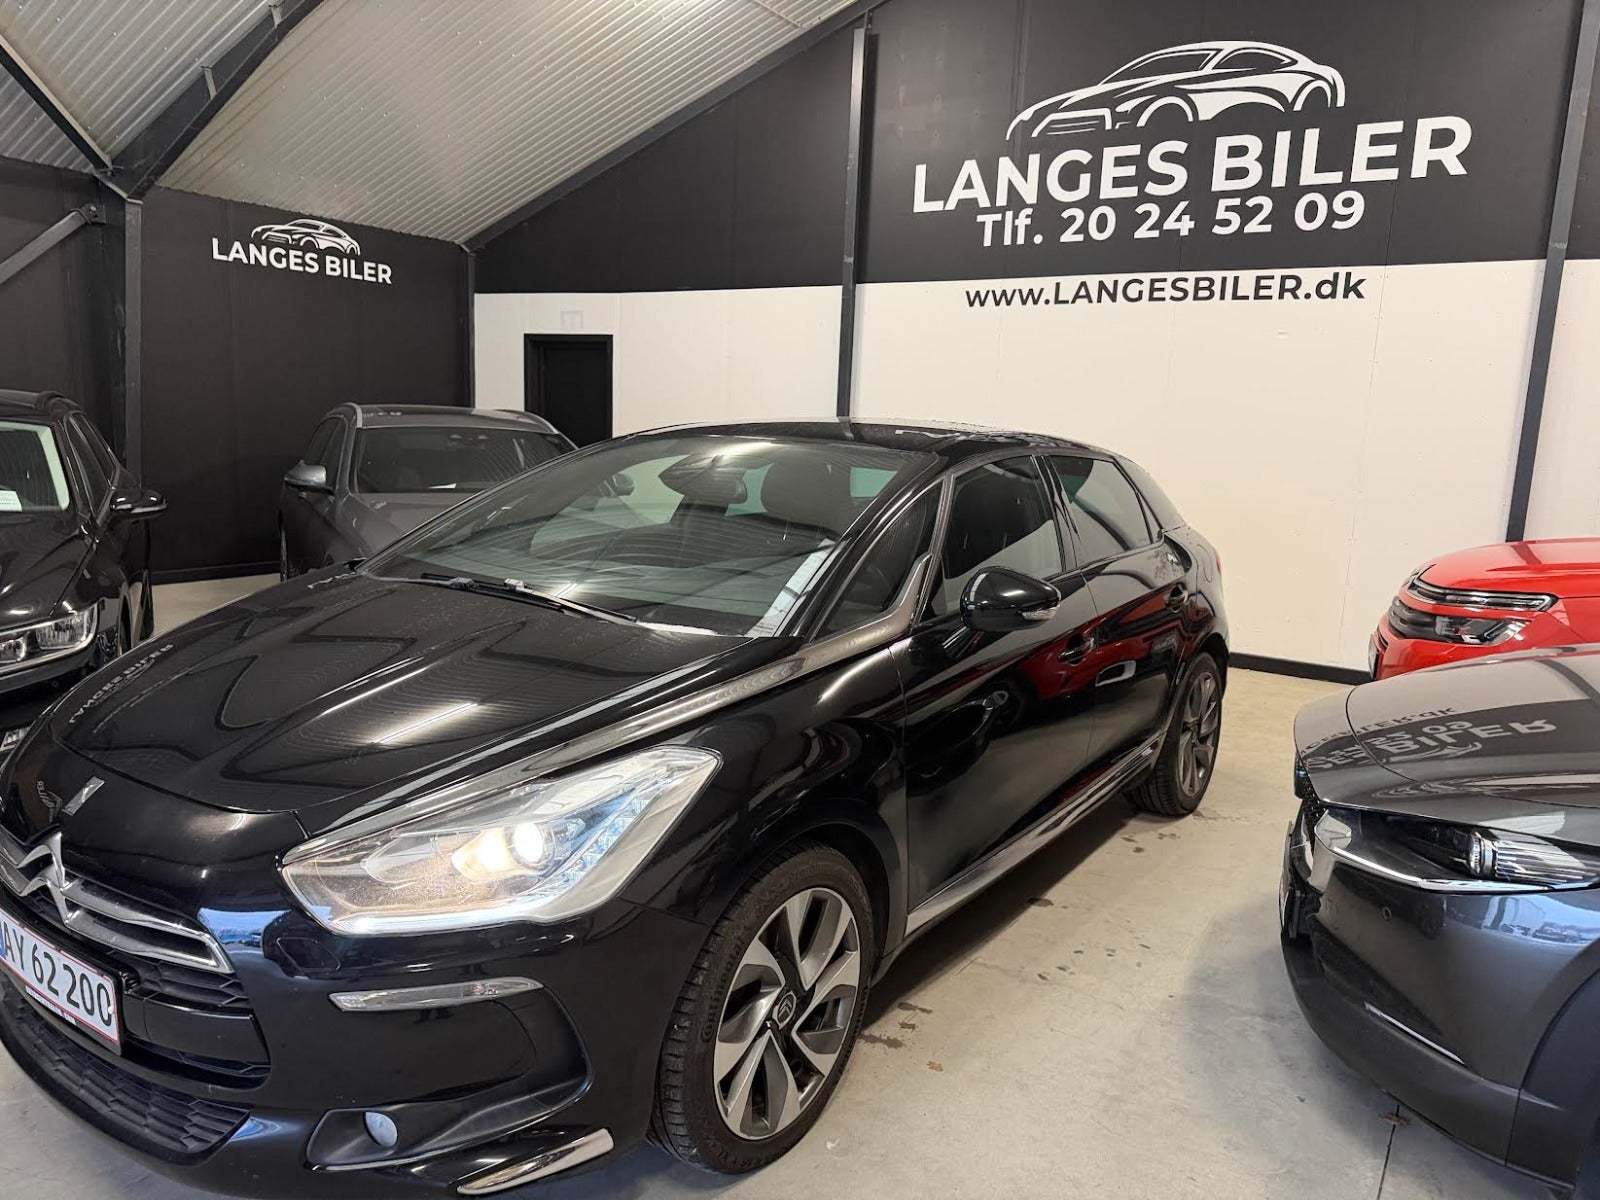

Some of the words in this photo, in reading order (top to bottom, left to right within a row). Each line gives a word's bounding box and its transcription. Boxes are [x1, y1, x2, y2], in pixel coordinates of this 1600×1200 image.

[912, 141, 1189, 213] LANGES
[1211, 116, 1472, 191] BILER
[976, 208, 1043, 247] Tlf.
[1060, 206, 1117, 243] 20
[1134, 201, 1195, 239] 24
[1212, 196, 1273, 234] 52
[1294, 191, 1365, 230] 09
[212, 238, 320, 274] LANGES
[325, 256, 392, 285] BILER
[965, 271, 1367, 308] www.LANGESBILER.dk
[3, 921, 25, 972] AY
[32, 943, 60, 997] 62
[62, 963, 112, 1027] 200
